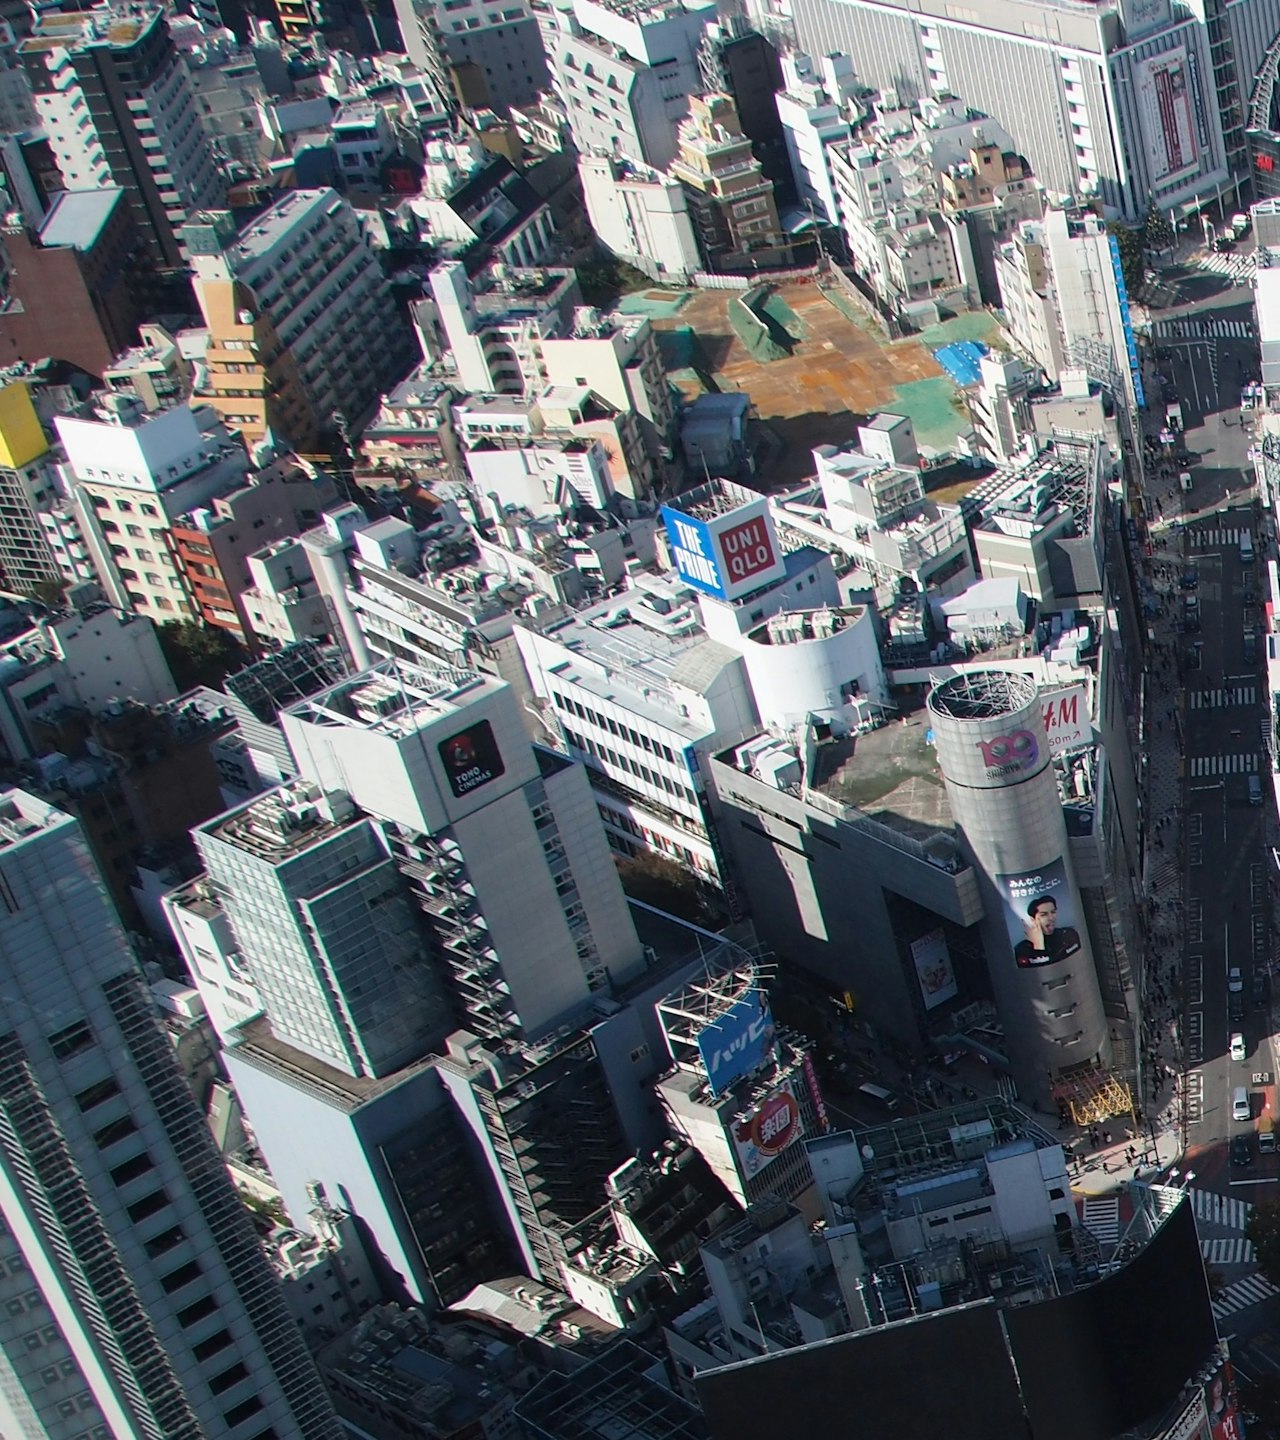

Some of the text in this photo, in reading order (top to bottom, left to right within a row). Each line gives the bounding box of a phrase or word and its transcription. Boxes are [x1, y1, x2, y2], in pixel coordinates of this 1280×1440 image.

[674, 519, 701, 546] THE
[726, 525, 762, 555] UNI
[676, 546, 722, 590] PRIME
[731, 549, 769, 576] QLO
[1041, 694, 1077, 732] H&M
[976, 730, 1040, 768] 109
[455, 765, 480, 783] TOHO
[458, 770, 492, 792] CINEMAS
[1008, 873, 1043, 889] みんなの
[761, 1103, 791, 1145] 楽園
